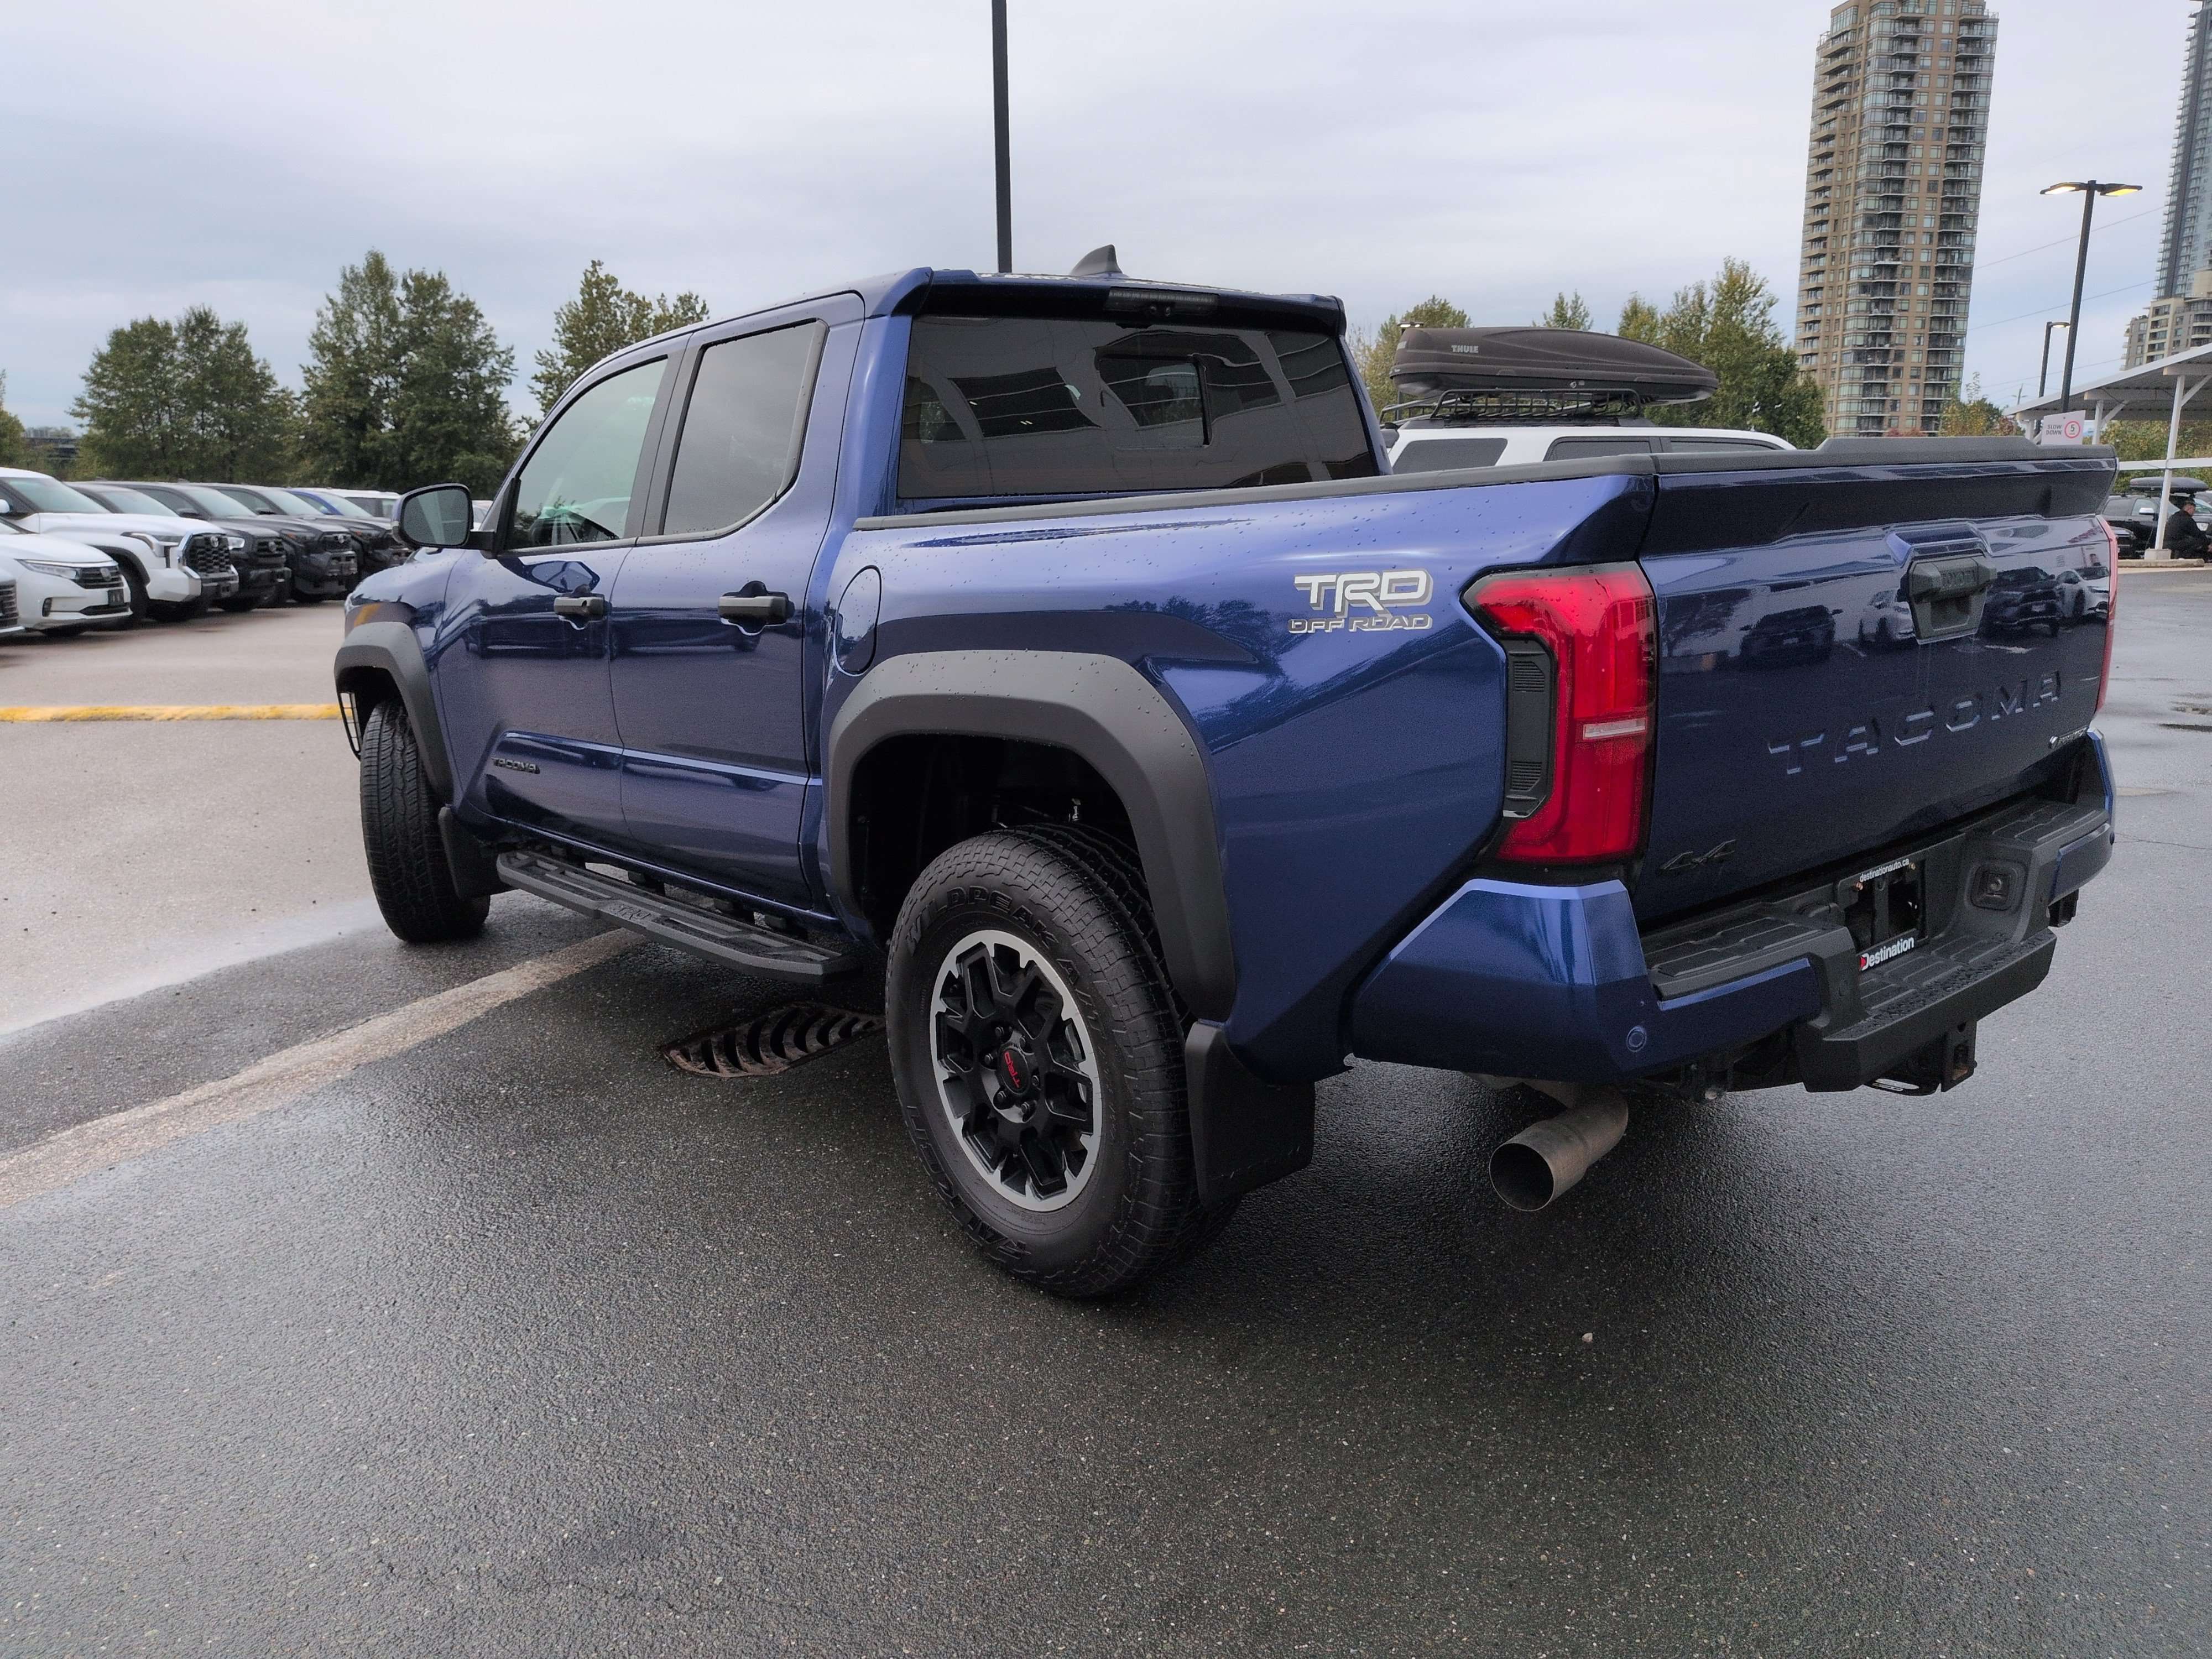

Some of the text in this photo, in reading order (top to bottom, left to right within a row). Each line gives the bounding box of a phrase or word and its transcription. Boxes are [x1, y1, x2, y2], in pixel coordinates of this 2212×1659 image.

[1451, 345, 1479, 353] THULE
[1294, 568, 1433, 618] TRD
[1288, 614, 1433, 634] OFF ROAD
[1768, 670, 2061, 775] TACOMA
[1859, 858, 1910, 883] destinationauto.ca
[905, 885, 1060, 958] WILDPEAK
[1859, 936, 1914, 972] Destination
[1004, 1050, 1021, 1088] TRD
